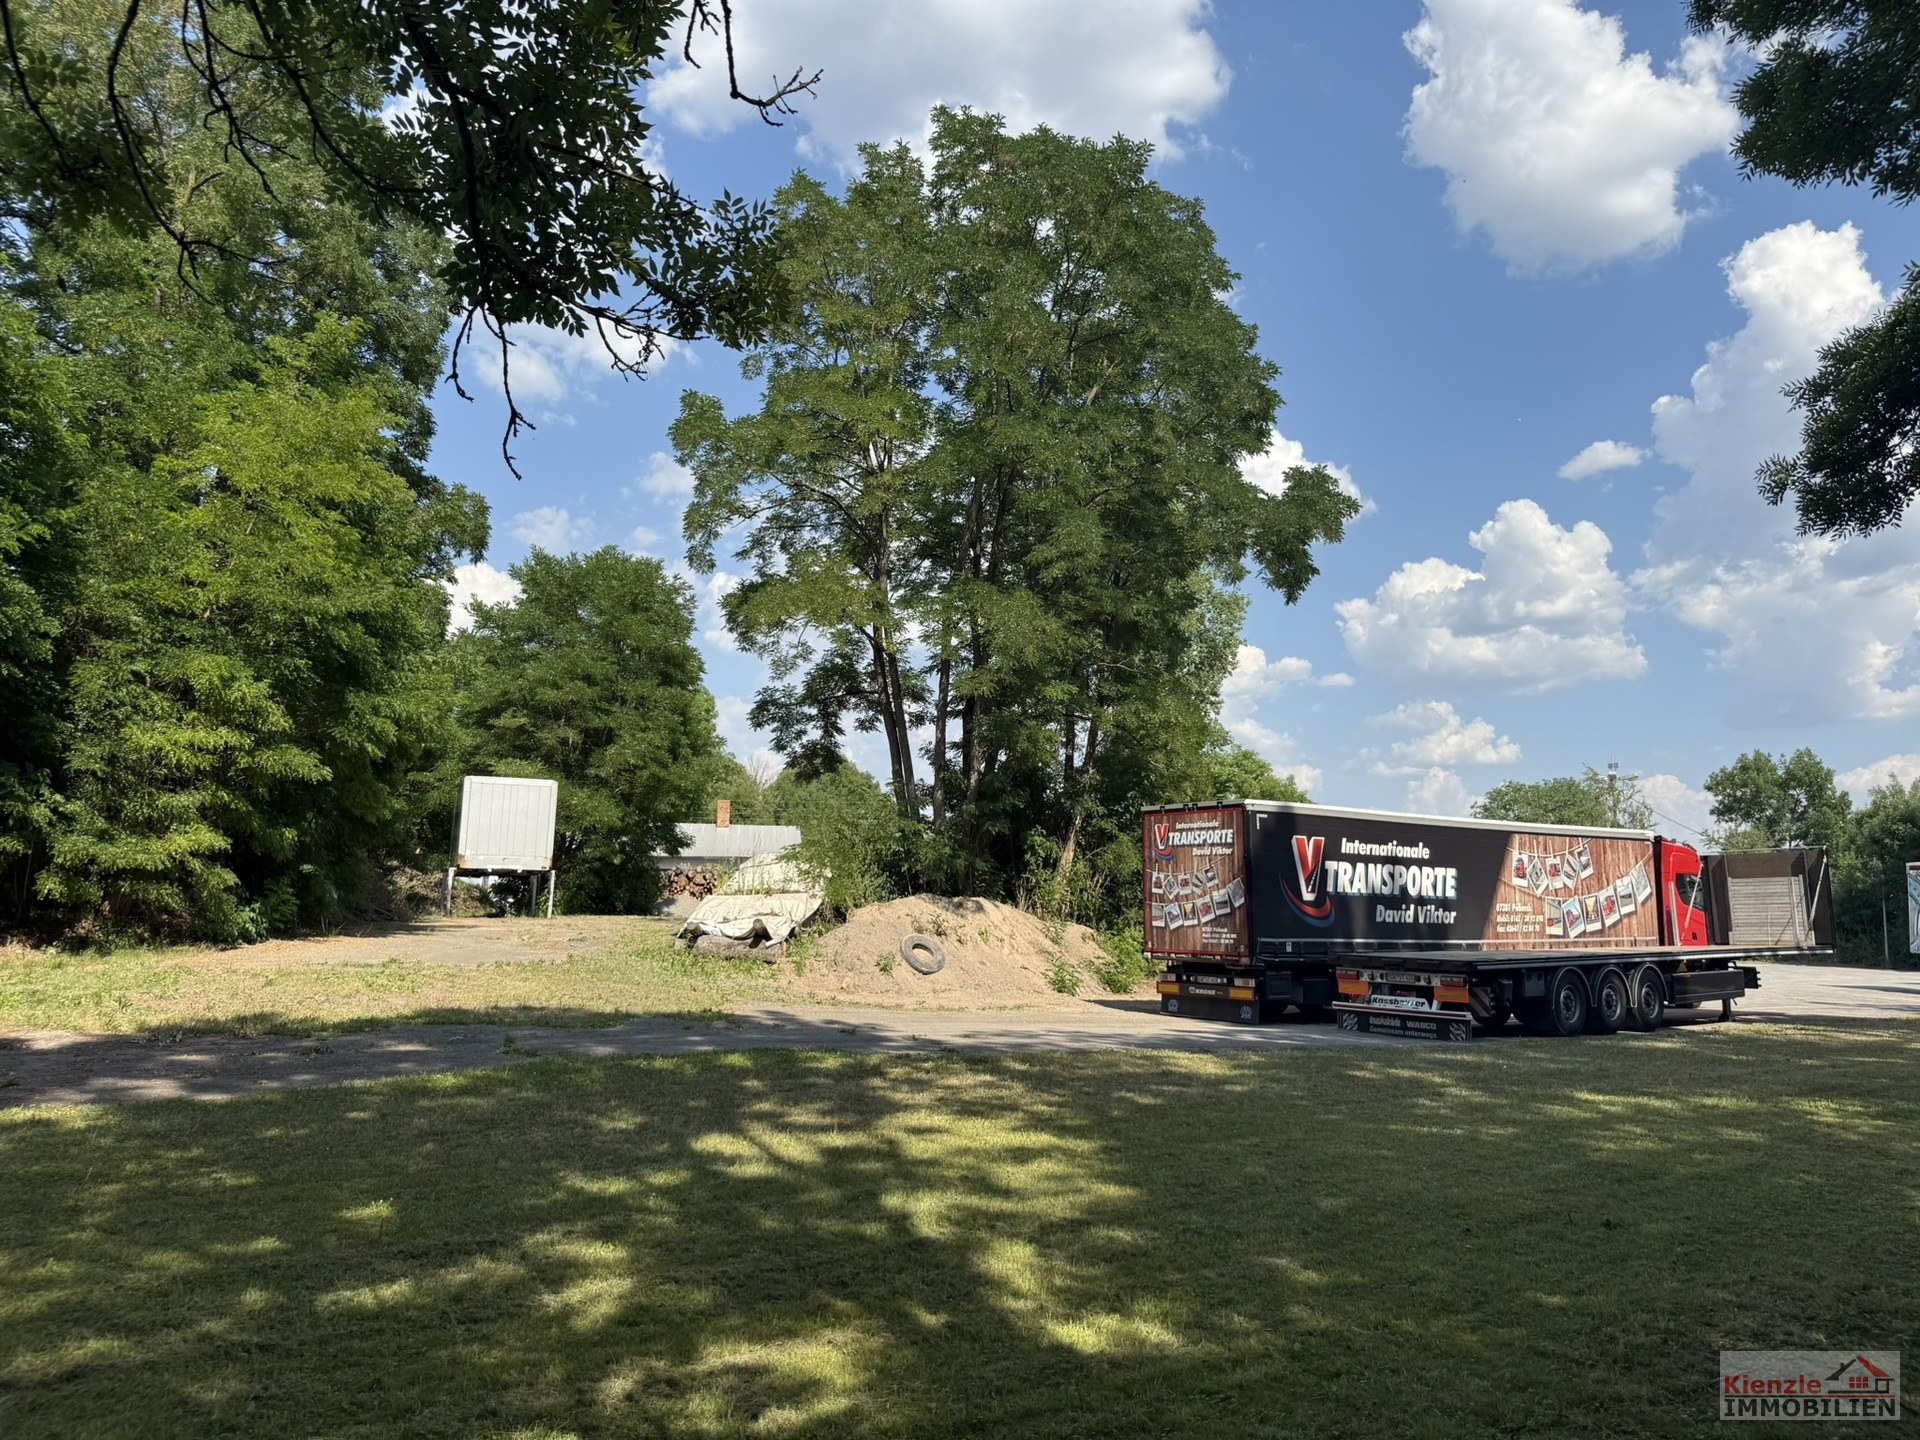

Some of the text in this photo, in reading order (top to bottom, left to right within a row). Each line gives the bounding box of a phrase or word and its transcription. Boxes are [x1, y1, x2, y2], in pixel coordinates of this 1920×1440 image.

[1176, 820, 1219, 829] Internationale
[1168, 829, 1233, 846] TRANSPORTE
[1192, 847, 1233, 856] David Viktor
[1341, 838, 1430, 859] Internationale
[1325, 861, 1457, 898] TRANSPORTE
[1376, 904, 1457, 924] David Viktor
[1369, 1025, 1437, 1039] Gemeinsam unterwegs
[1406, 1020, 1437, 1030] WABCO
